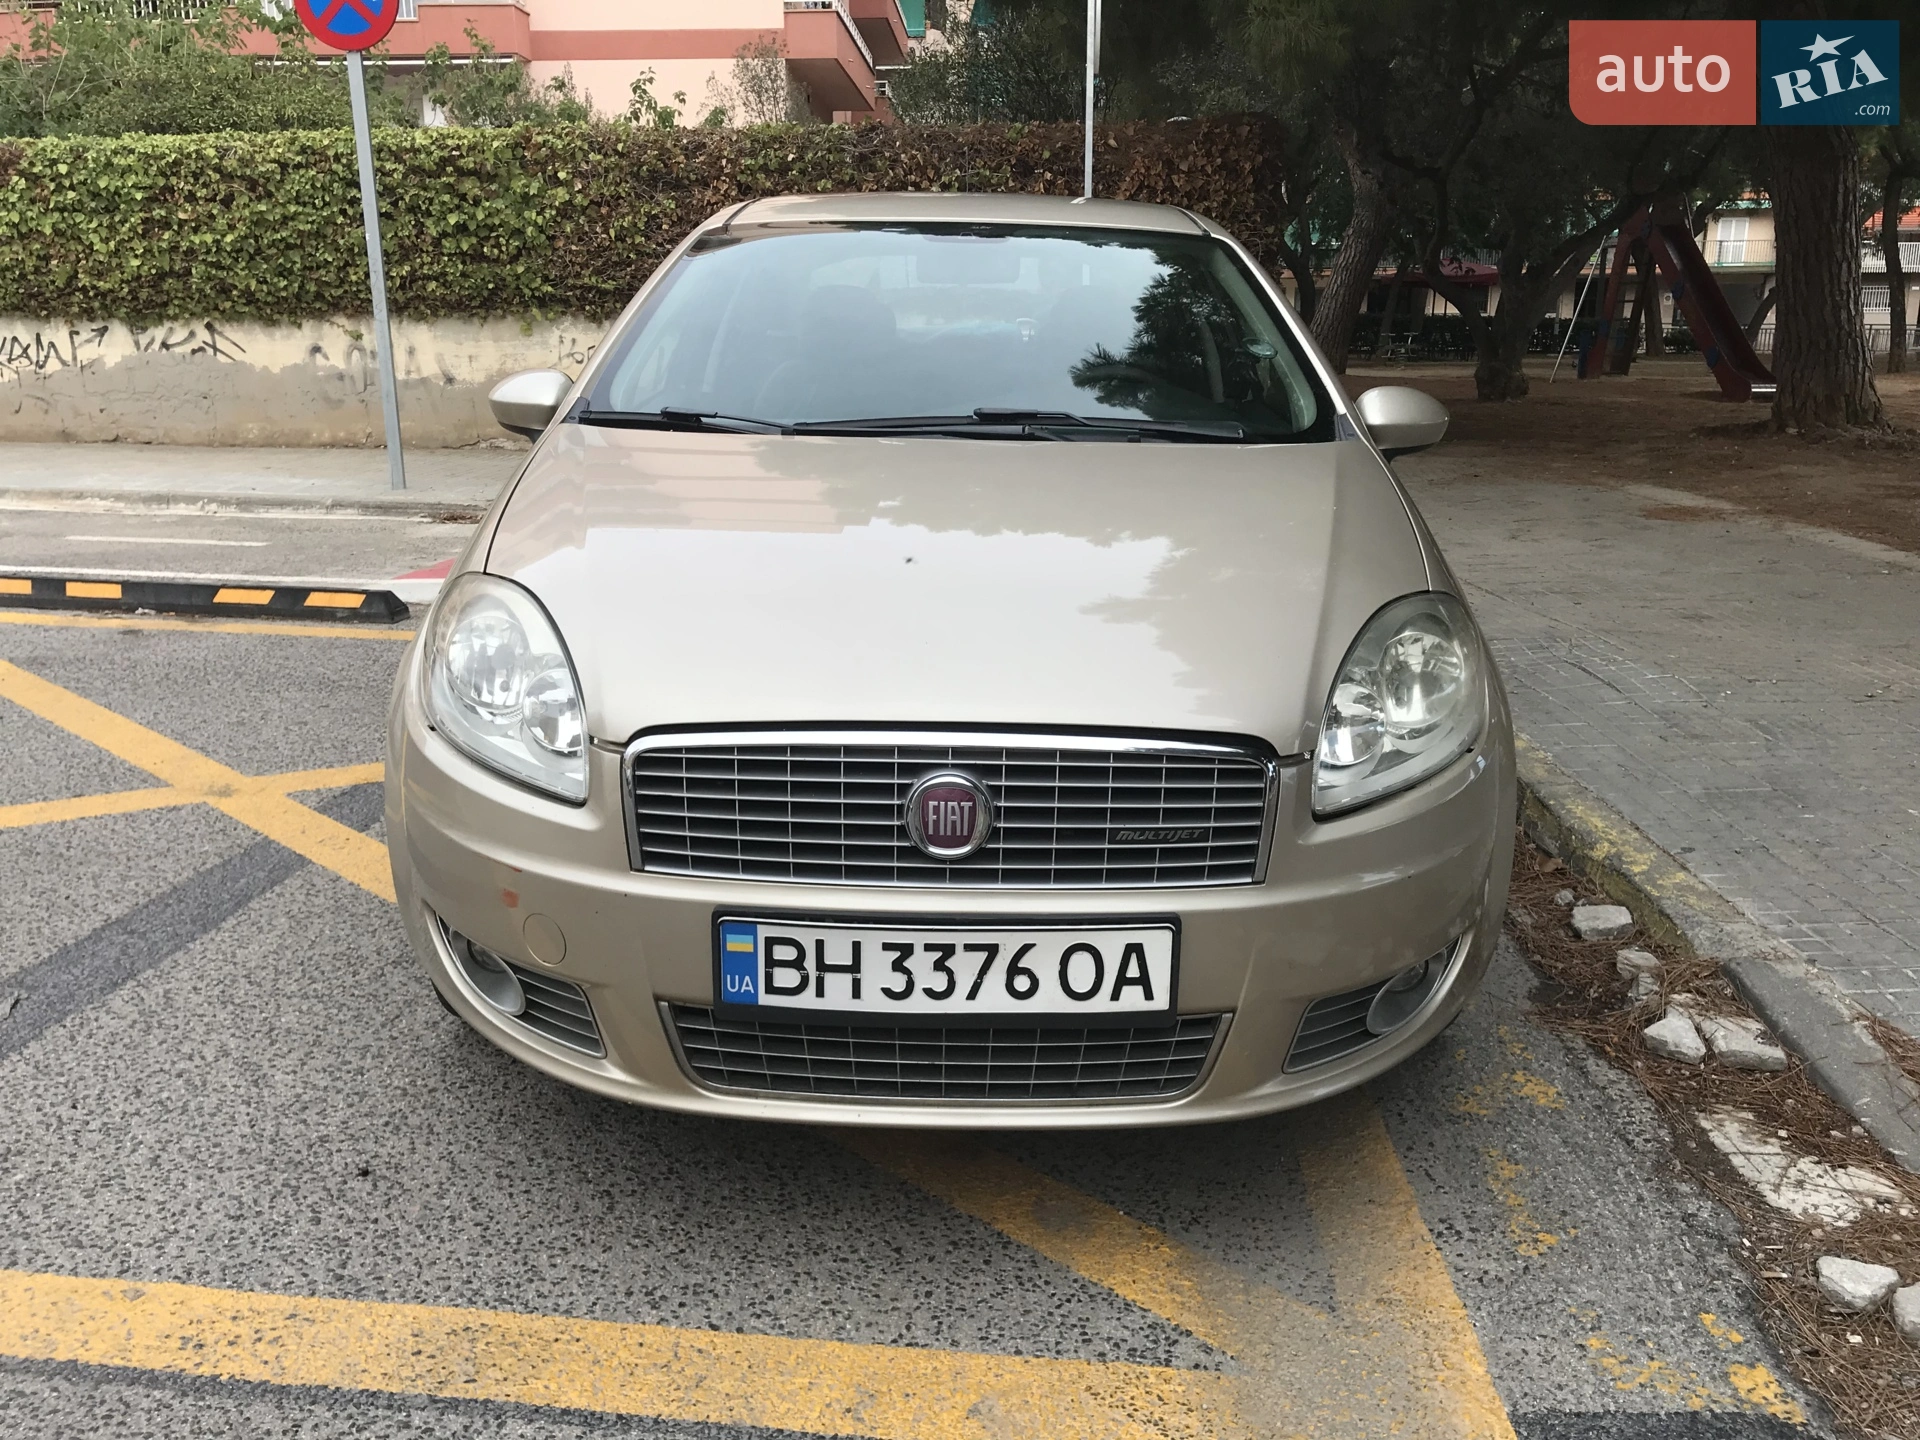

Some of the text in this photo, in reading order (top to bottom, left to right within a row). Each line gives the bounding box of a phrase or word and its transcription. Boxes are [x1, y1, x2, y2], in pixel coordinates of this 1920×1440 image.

[928, 801, 973, 836] FIAT
[1115, 829, 1204, 842] MULTIJET
[764, 936, 1154, 1002] BH 3376 OA
[726, 974, 755, 994] UA
